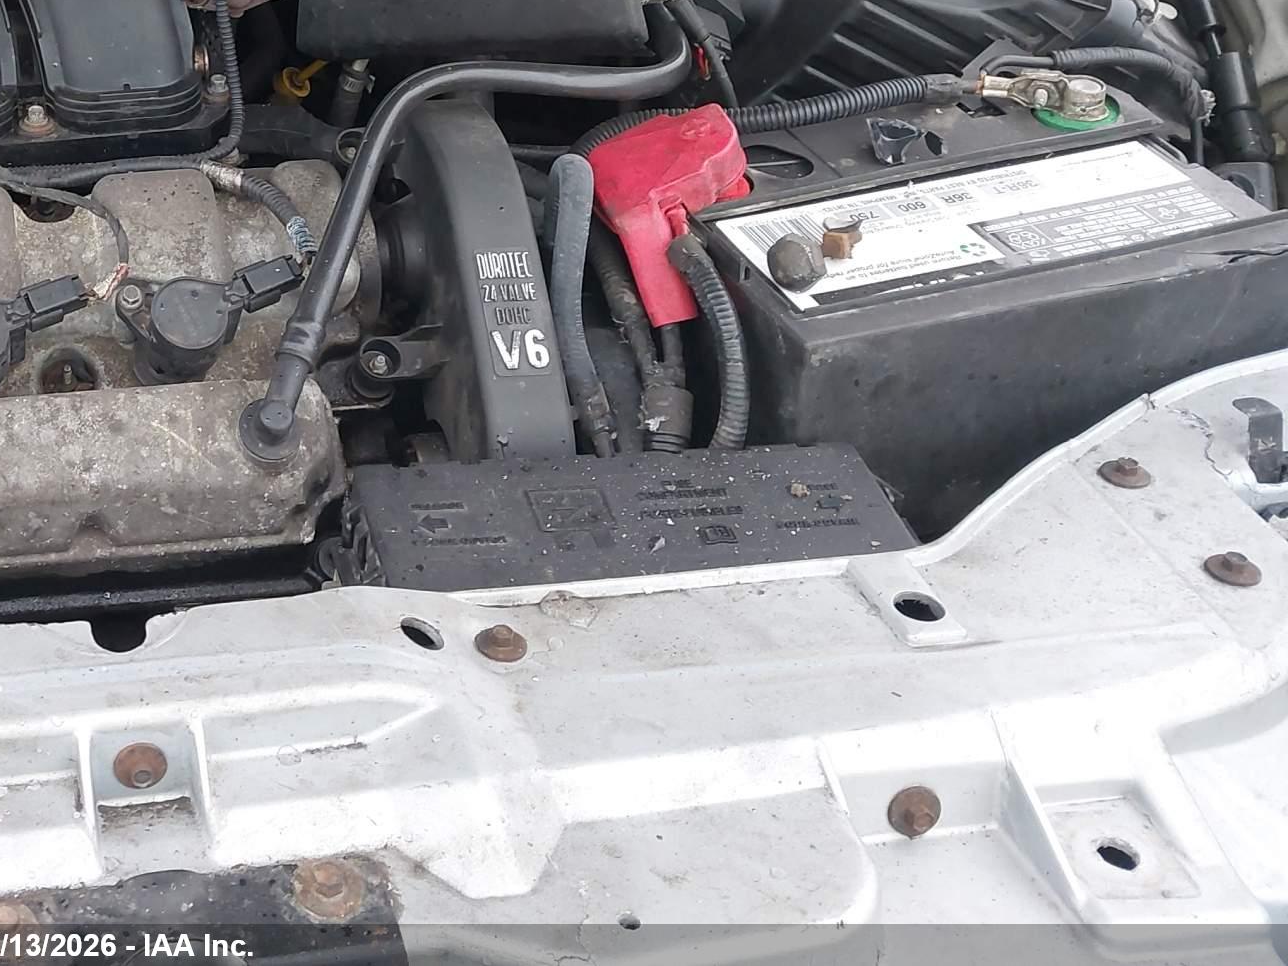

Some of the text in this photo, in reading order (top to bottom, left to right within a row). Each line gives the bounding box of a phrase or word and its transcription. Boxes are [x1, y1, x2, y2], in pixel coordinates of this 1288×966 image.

[897, 200, 927, 213] 600
[940, 191, 974, 205] 36R
[848, 210, 880, 224] 750
[475, 251, 534, 280] DURATEC
[481, 282, 537, 302] 24 VALVE
[495, 307, 533, 326] DOHC
[490, 329, 550, 370] V6
